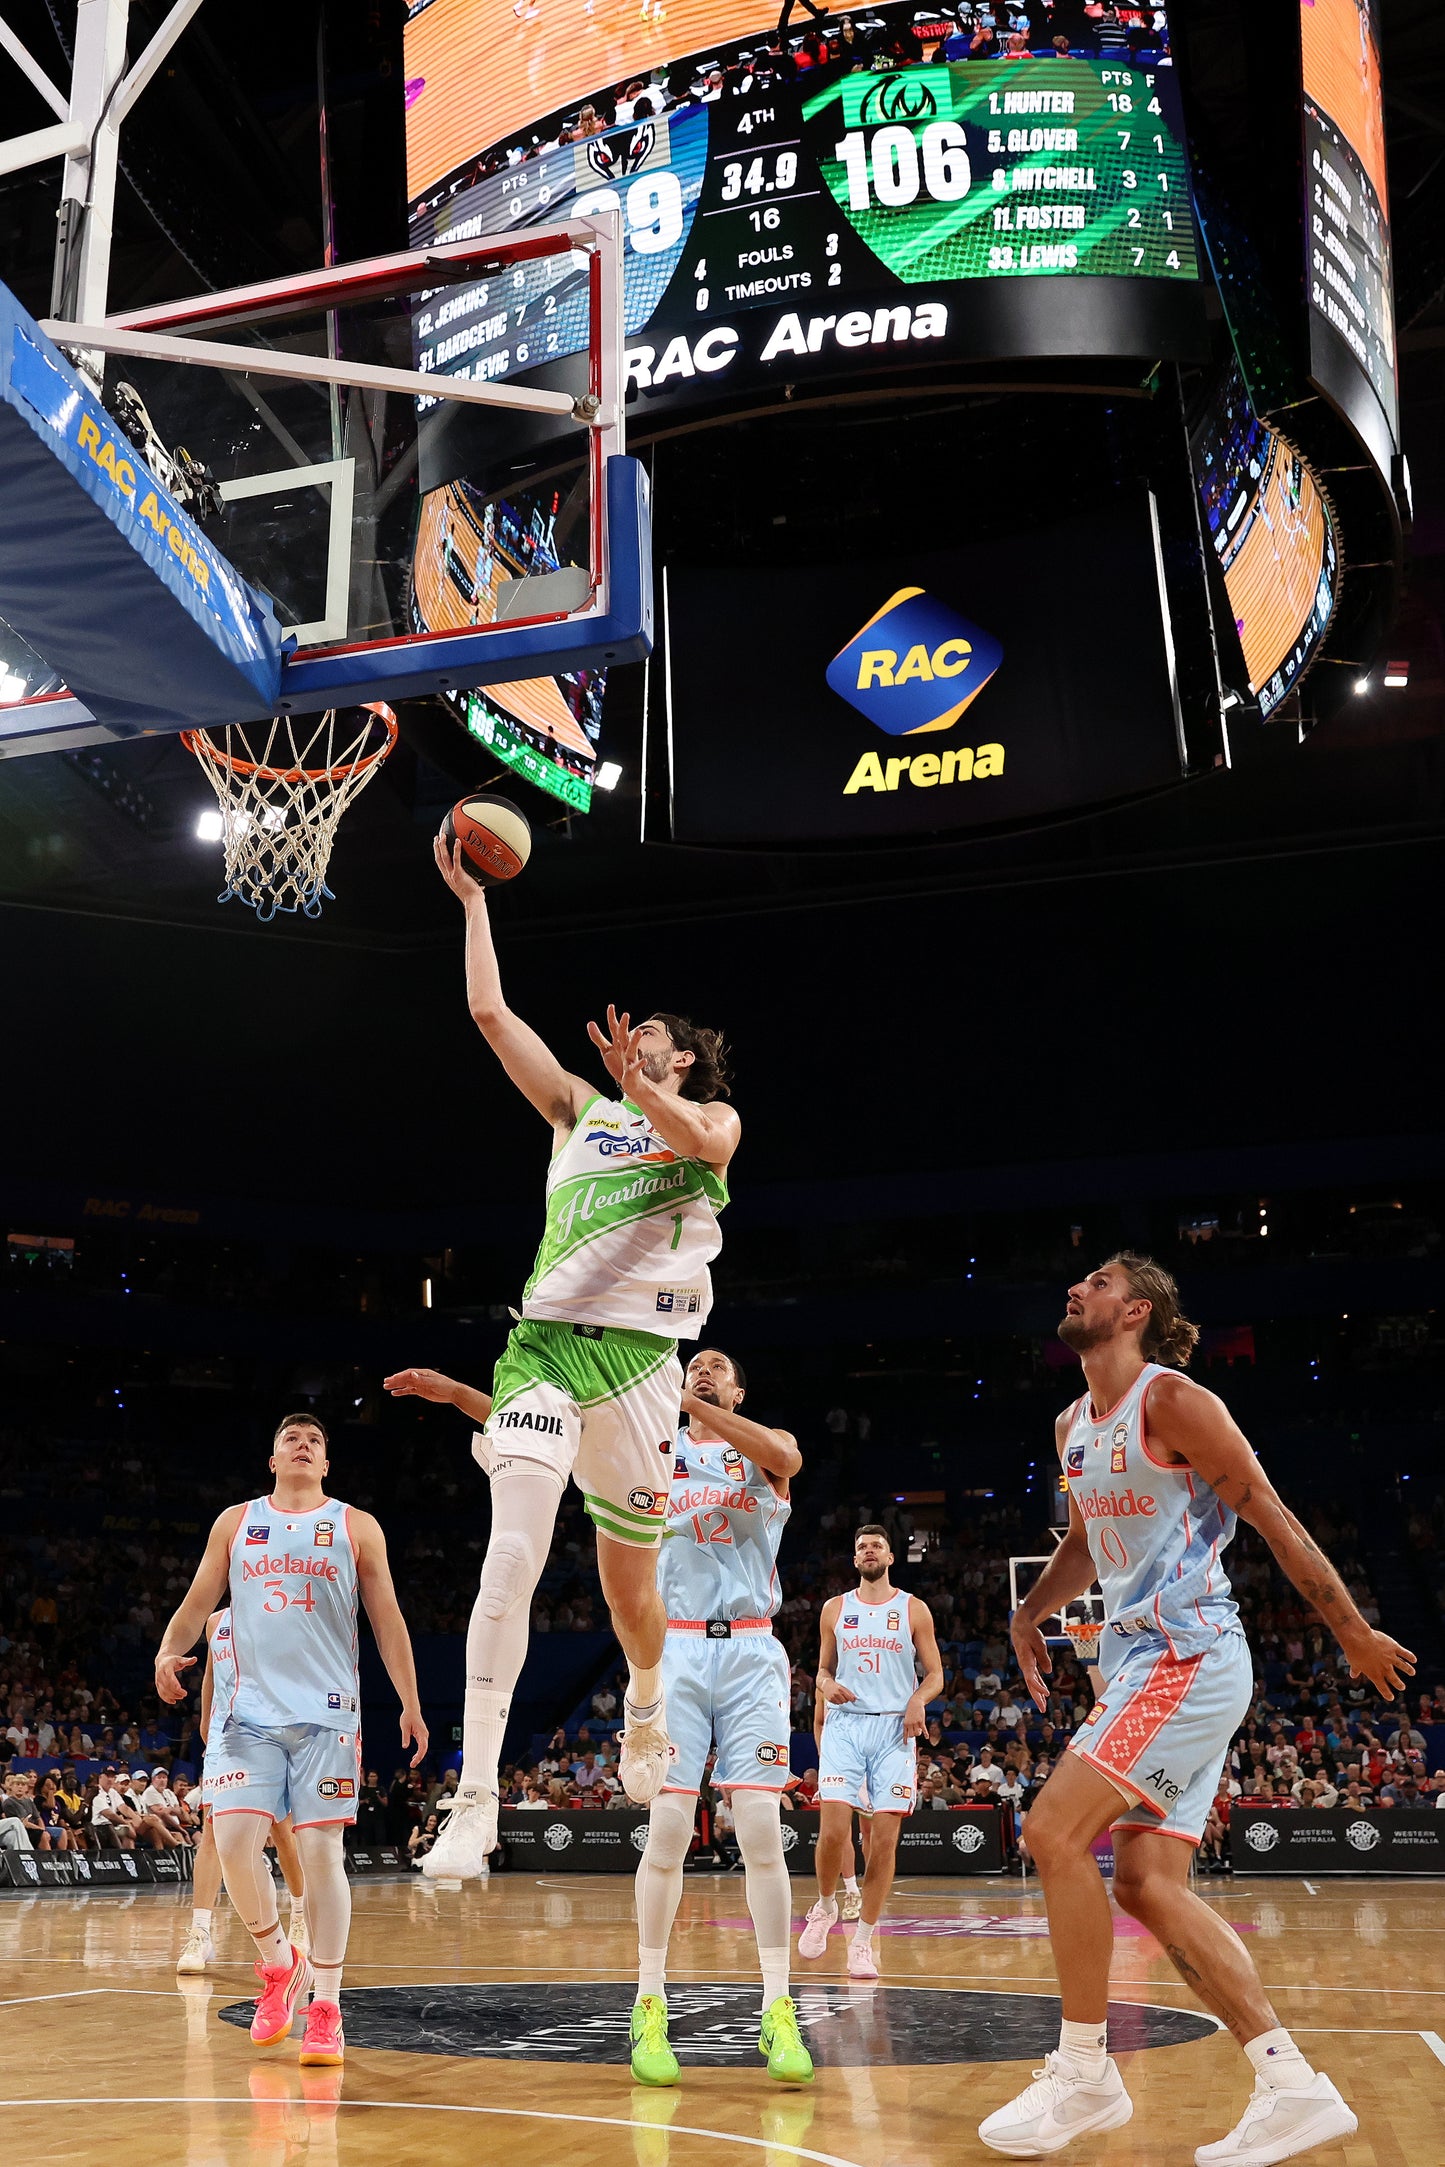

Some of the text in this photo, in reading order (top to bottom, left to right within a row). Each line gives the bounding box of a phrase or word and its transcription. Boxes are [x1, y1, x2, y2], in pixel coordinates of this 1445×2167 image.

[1101, 70, 1155, 88] PTS F
[989, 91, 1162, 116] 1. HUNTER 18 4
[736, 107, 775, 135] 4TH
[987, 128, 1164, 154] 5. GLOVER 7 1
[502, 164, 548, 194] PTS F
[721, 152, 797, 201] 34.9
[834, 120, 973, 213] 106
[992, 167, 1169, 192] 8. MITCHELL 3 1
[510, 198, 522, 216] 0
[539, 186, 550, 204] 0
[749, 209, 781, 232] 16
[993, 205, 1174, 231] 11. FOSTER 2 1
[694, 233, 839, 281] 4 FOULS 3
[987, 244, 1180, 270] 33. LEWIS 7 4
[418, 313, 434, 339] 12.
[435, 284, 489, 329] JENKINS
[512, 270, 525, 288] 8
[544, 260, 552, 276] 1
[695, 263, 842, 312] 0 TIMEOUTS 2
[418, 295, 557, 374] 31. RAKOCEVIC 7 2
[516, 343, 529, 363] 6
[547, 333, 558, 353] 2
[624, 301, 950, 393] RAC Arena
[77, 411, 210, 590] RAC Arena
[856, 638, 973, 690] RAC
[471, 704, 495, 745] 106
[843, 742, 1005, 794] Arena
[556, 1165, 687, 1244] Heartland
[670, 1213, 683, 1250] 1
[498, 1411, 563, 1437] TRADIE
[725, 1451, 739, 1461] NBL
[633, 1492, 650, 1508] NBL
[668, 1485, 758, 1518] Adelaide
[1078, 1488, 1157, 1521] delaide
[691, 1511, 733, 1544] 12
[1100, 1527, 1128, 1570] 0
[241, 1555, 340, 1583] Adelaide
[262, 1579, 317, 1614] 34
[842, 1634, 903, 1653] Adelaide
[857, 1651, 880, 1673] 31
[760, 1749, 774, 1760] NBL
[322, 1783, 335, 1794] NBL
[544, 1830, 573, 1839] HOOPS
[952, 1830, 984, 1841] HOOPS
[1245, 1829, 1279, 1839] HOOPS
[1346, 1827, 1380, 1838] HOOPS
